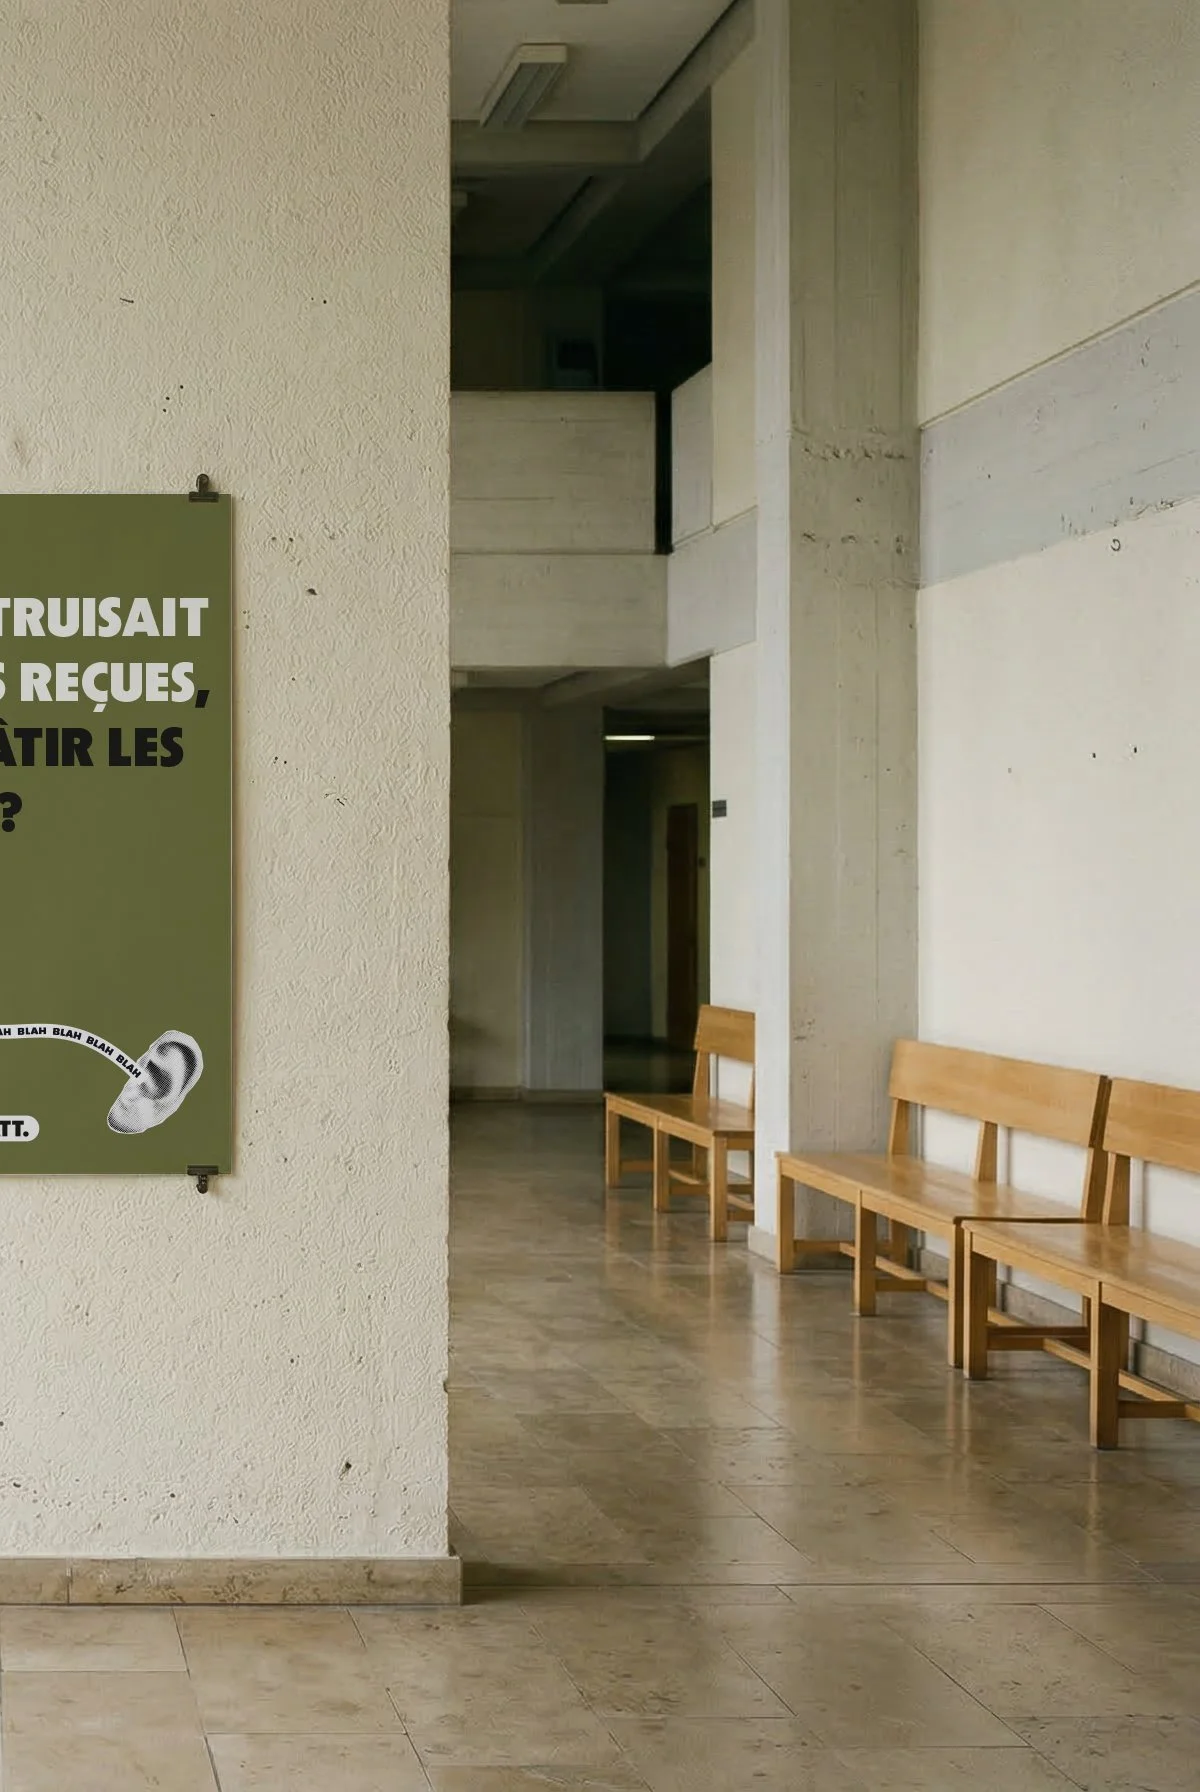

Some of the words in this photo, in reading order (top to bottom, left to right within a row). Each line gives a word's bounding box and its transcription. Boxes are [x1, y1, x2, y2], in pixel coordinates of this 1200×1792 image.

[20, 661, 210, 713] REÇUES,
[108, 726, 184, 768] LES
[17, 1026, 47, 1036] BLAH
[52, 1027, 82, 1041] BLAH
[86, 1036, 115, 1057] BLAH
[115, 1054, 142, 1079] BLAH
